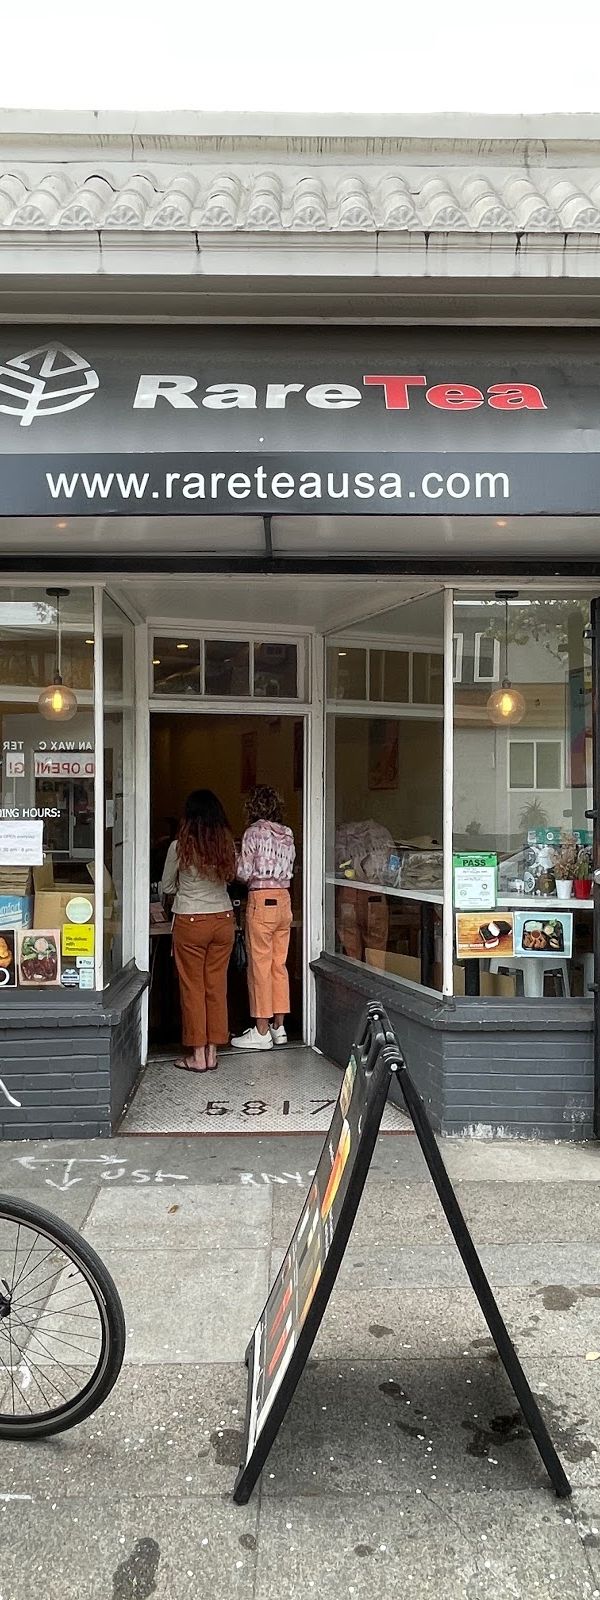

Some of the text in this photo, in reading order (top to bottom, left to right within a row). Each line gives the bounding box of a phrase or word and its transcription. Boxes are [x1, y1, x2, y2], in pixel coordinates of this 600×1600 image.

[45, 465, 510, 500] www.rareteausa.com
[22, 808, 61, 818] HOURS:
[462, 859, 486, 867] PASS
[206, 1100, 337, 1116] 5817
